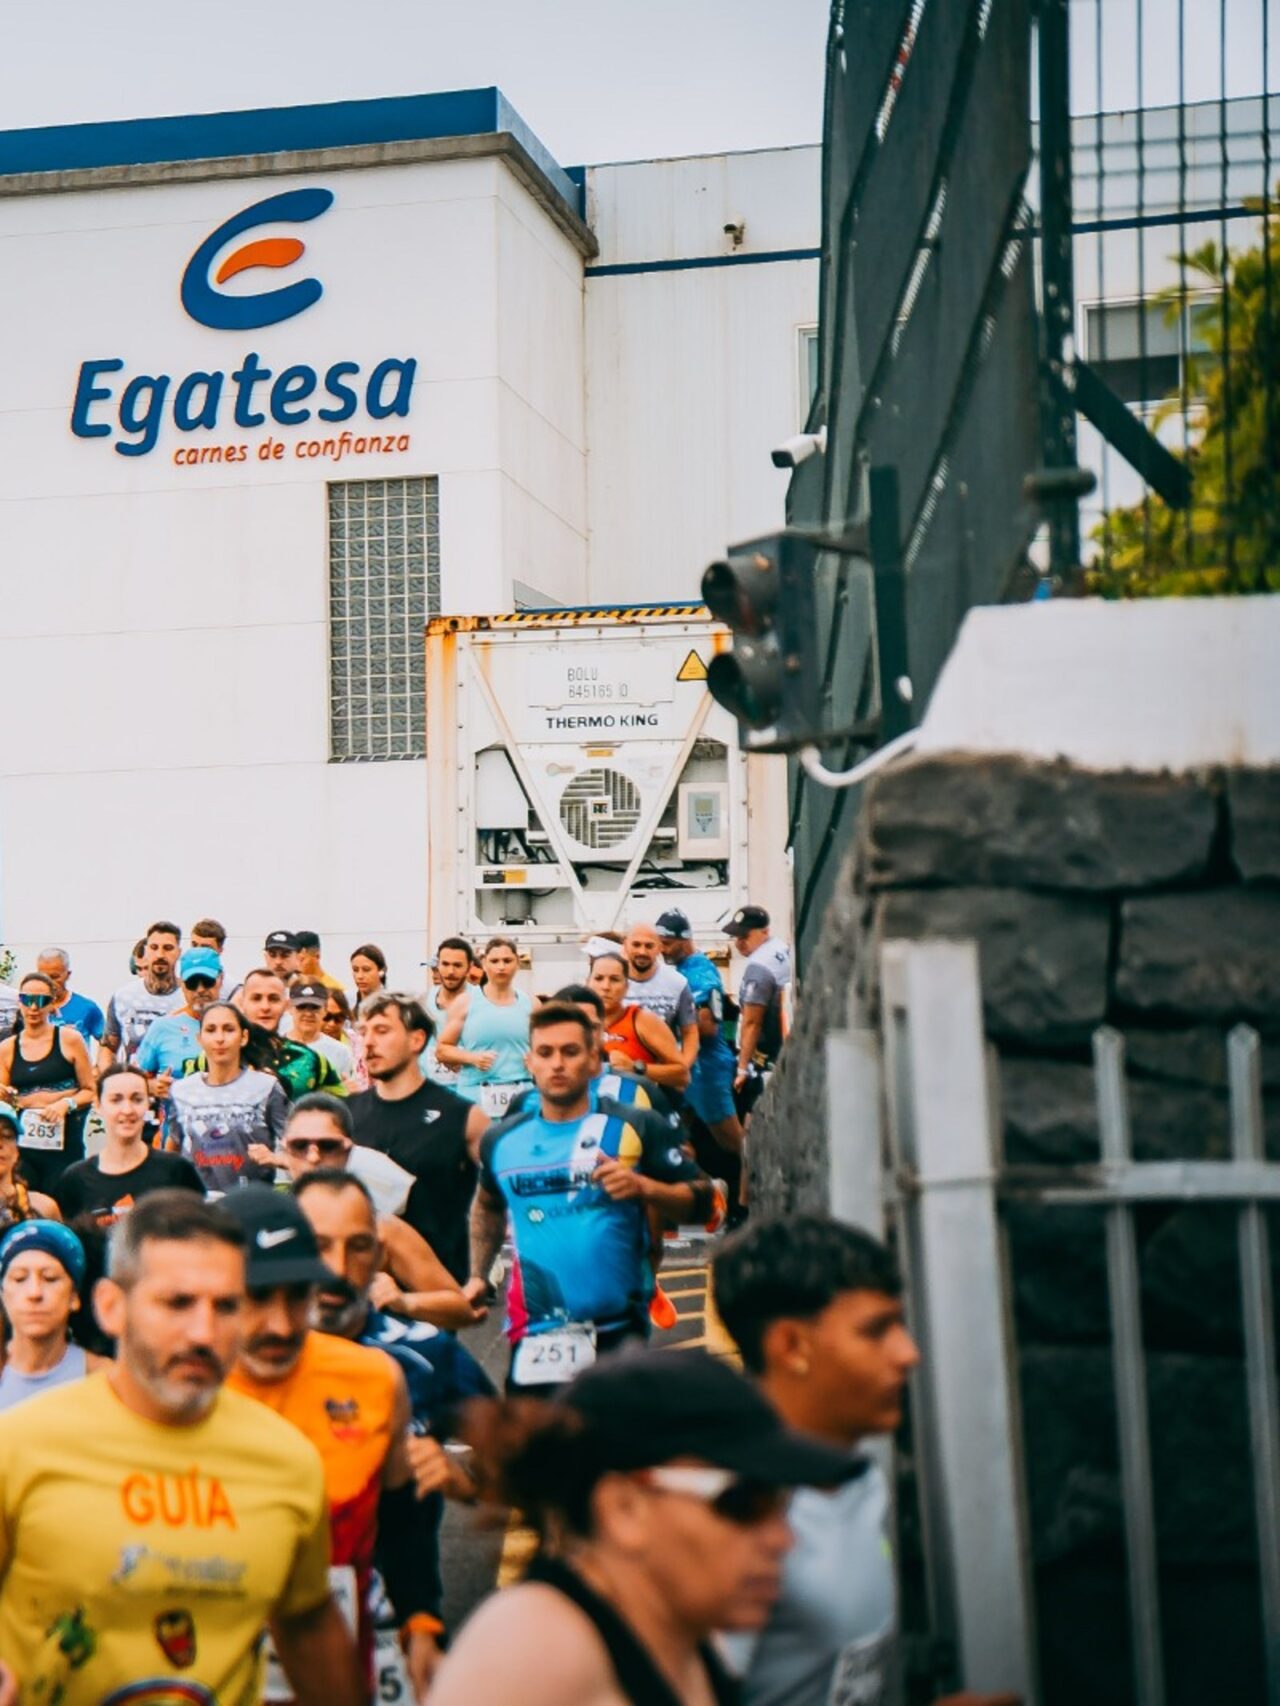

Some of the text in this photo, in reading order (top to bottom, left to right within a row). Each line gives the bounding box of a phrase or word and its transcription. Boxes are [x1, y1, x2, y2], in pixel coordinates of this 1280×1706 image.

[71, 353, 417, 456] Egatesa
[174, 432, 410, 465] carnes de confianza
[567, 667, 598, 681] BOLU
[546, 713, 658, 729] THERMO KING
[28, 1124, 56, 1139] 263
[533, 1343, 577, 1364] 251
[121, 1464, 238, 1532] GUÍA
